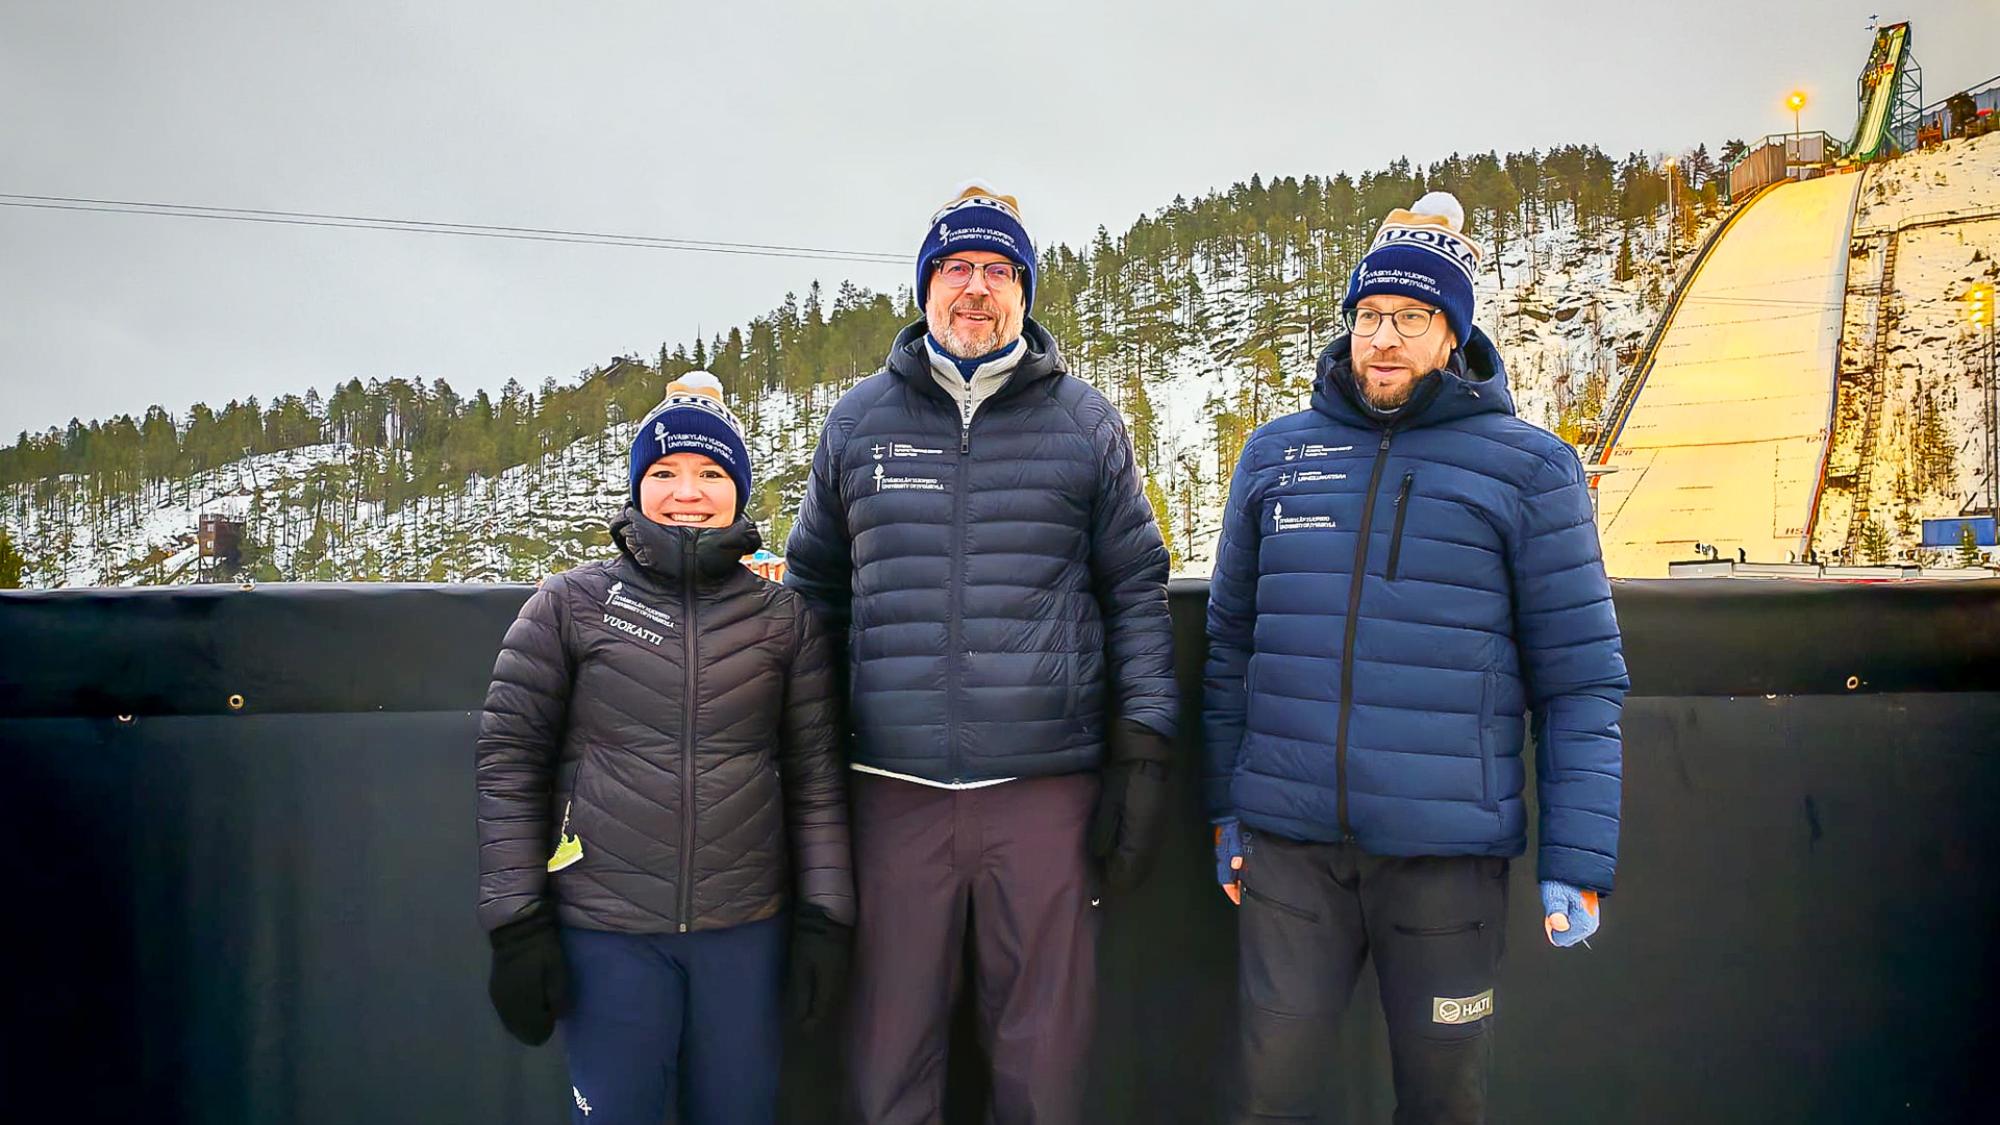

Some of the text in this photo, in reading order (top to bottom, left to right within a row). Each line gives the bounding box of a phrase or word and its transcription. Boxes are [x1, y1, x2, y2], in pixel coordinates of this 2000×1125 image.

[949, 234, 982, 242] UNIVERSITY
[1404, 271, 1436, 285] YLIOPISTO
[667, 433, 708, 442] JYVÄSKYLÄN
[668, 440, 704, 448] UNIVERSITY
[603, 613, 664, 646] VUOKATTI
[1463, 997, 1490, 1016] HALTI
